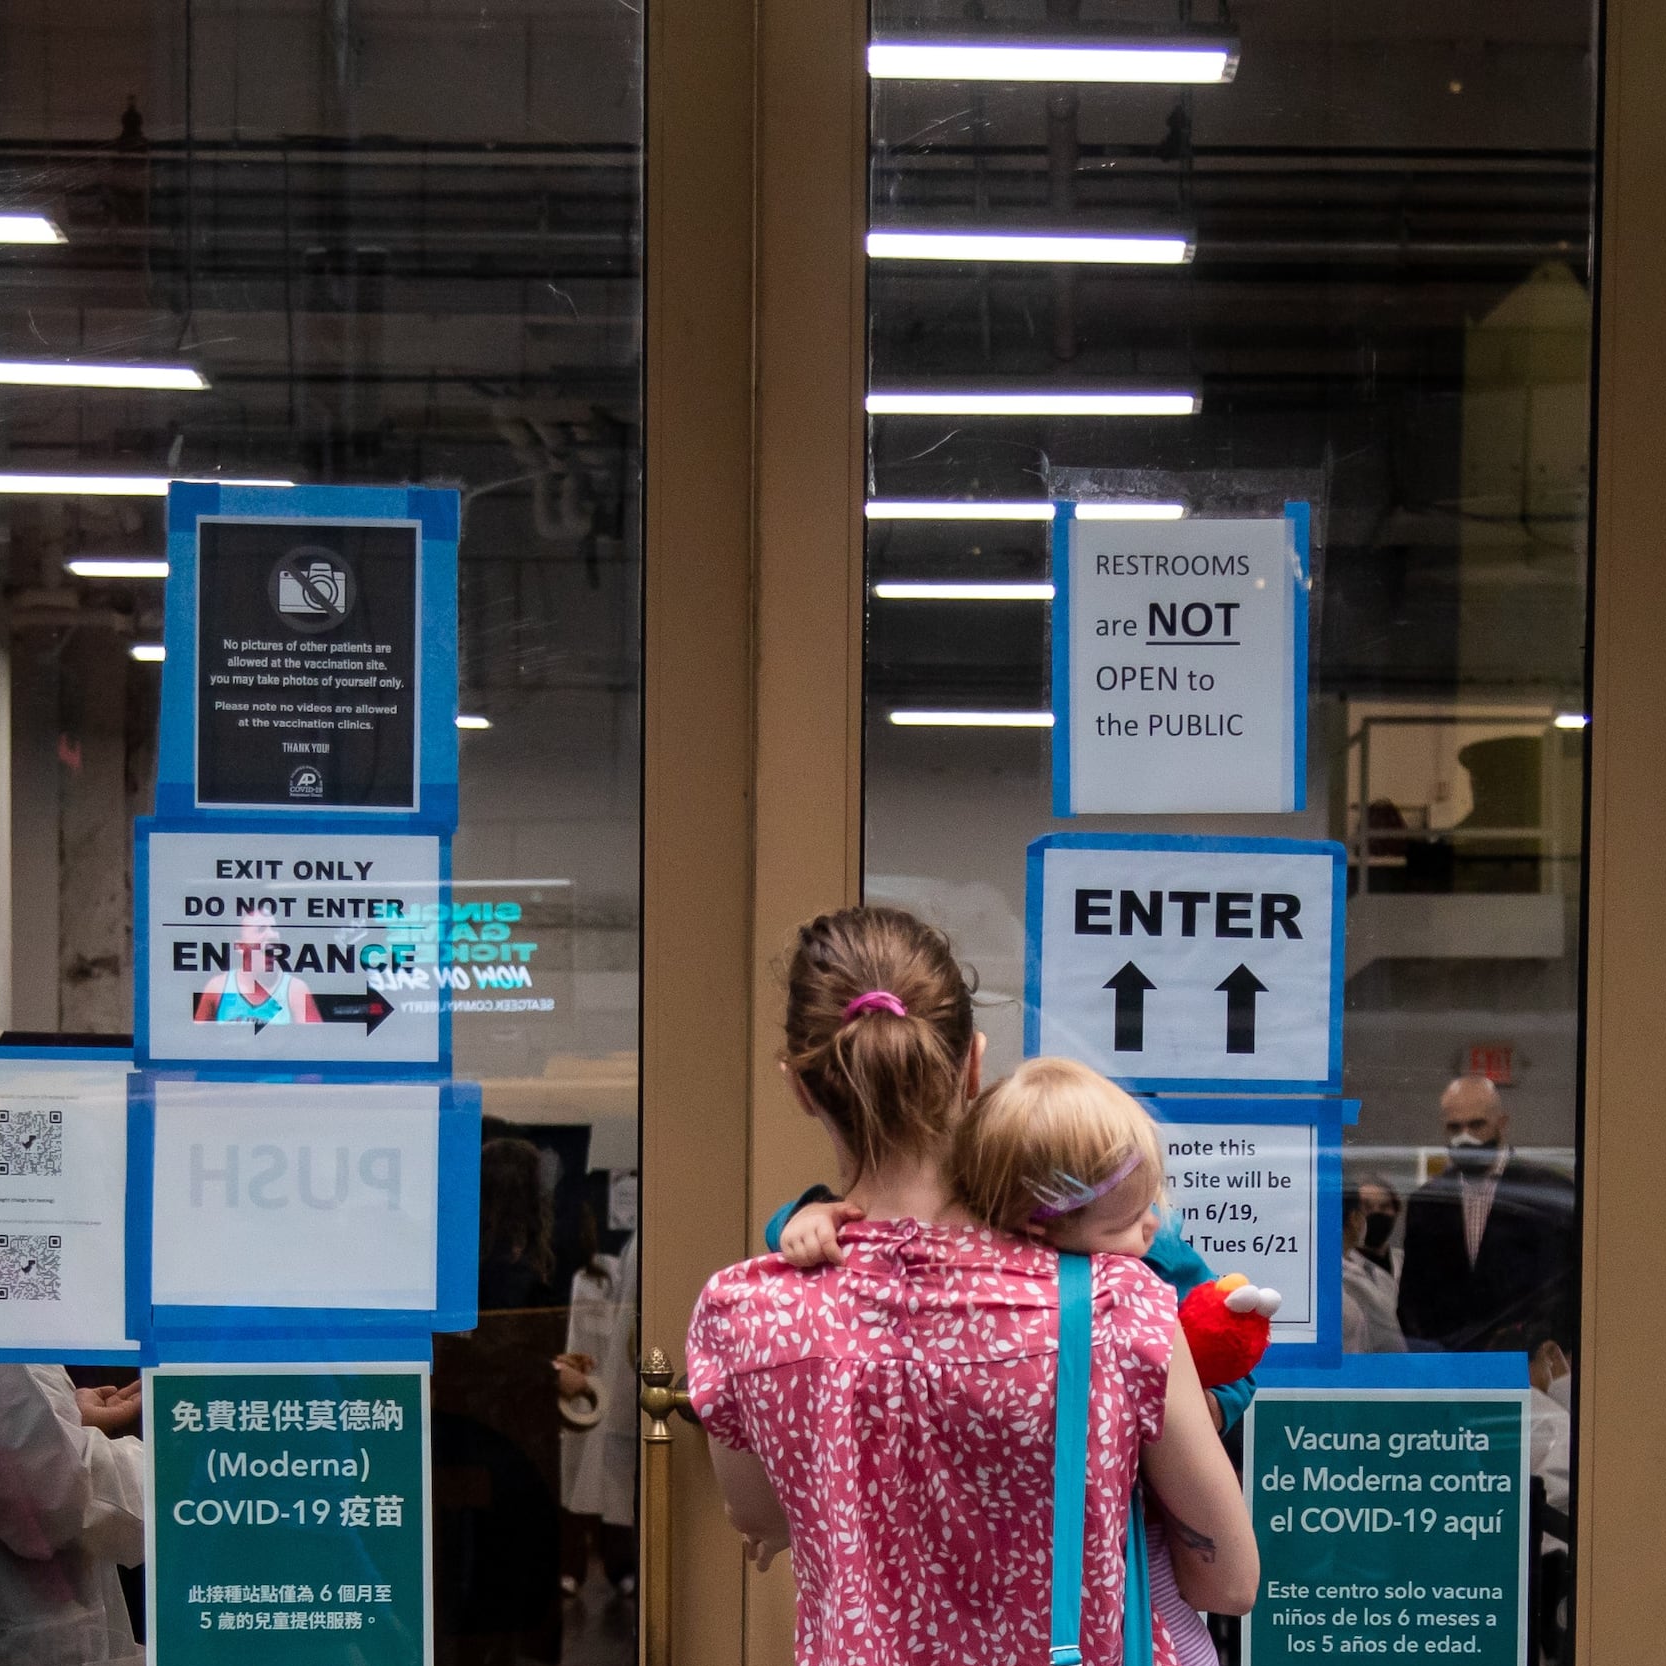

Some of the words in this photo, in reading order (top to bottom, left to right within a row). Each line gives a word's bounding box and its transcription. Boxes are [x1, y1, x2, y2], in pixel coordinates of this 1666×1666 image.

[1096, 554, 1250, 576] RESTROOMS
[1095, 619, 1138, 637] are
[1148, 602, 1241, 638] NOT
[223, 638, 239, 650] No
[241, 640, 283, 654] pictures
[286, 640, 298, 652] of
[300, 641, 328, 653] other
[330, 642, 373, 655] patients
[375, 643, 392, 654] are
[227, 656, 269, 669] allowed
[270, 658, 282, 669] at
[284, 658, 301, 669] the
[304, 658, 364, 670] vaccination
[210, 675, 231, 687] you
[232, 675, 255, 687] may
[257, 674, 280, 686] take
[282, 676, 319, 689] photos
[321, 676, 333, 687] of
[334, 677, 377, 689] yourself
[1096, 665, 1178, 691] OPEN
[1187, 669, 1215, 691] to
[1096, 712, 1139, 736] the
[1149, 713, 1244, 737] PUBLIC
[282, 742, 311, 754] THANK
[311, 742, 331, 755] YOU!
[216, 859, 283, 880] EXIT
[293, 860, 373, 881] ONLY
[184, 896, 225, 917] DO
[236, 897, 297, 918] NOT
[307, 898, 405, 919] ENTER
[1074, 888, 1303, 940] ENTER
[173, 941, 416, 974] ENTRANCE
[1168, 1141, 1213, 1156] note
[1219, 1139, 1256, 1157] this
[1183, 1171, 1220, 1188] Site
[1227, 1171, 1261, 1188] will
[1268, 1171, 1292, 1188] be
[1206, 1203, 1258, 1224] 6/19,
[1201, 1236, 1246, 1253] Tues
[1252, 1234, 1298, 1256] 6/21
[171, 1399, 404, 1432] 免費提供莫德納
[1284, 1426, 1380, 1451] Vacuna
[1388, 1426, 1490, 1458] gratuita
[207, 1448, 370, 1483] (Moderna)
[1261, 1465, 1295, 1492] de
[1303, 1465, 1422, 1492] Moderna
[1429, 1470, 1512, 1492] contra
[173, 1498, 331, 1526] COVID-19
[339, 1494, 405, 1528] 疫苗
[1270, 1506, 1293, 1532] el
[1300, 1507, 1437, 1533] COVID-19
[1443, 1508, 1505, 1541] aquí
[319, 1584, 333, 1602] 6
[337, 1584, 393, 1604] 個月至
[1267, 1581, 1309, 1600] Este
[1315, 1583, 1379, 1600] centro
[1384, 1580, 1426, 1600] solo
[1432, 1585, 1503, 1600] vacuna
[200, 1611, 212, 1630] 5
[1272, 1608, 1326, 1627] niños
[1331, 1608, 1358, 1627] de
[1363, 1608, 1392, 1627] los
[1397, 1609, 1410, 1626] 6
[1416, 1612, 1480, 1627] meses
[1485, 1613, 1497, 1627] a
[1287, 1634, 1316, 1653] los
[1322, 1635, 1333, 1653] 5
[1340, 1635, 1387, 1653] años
[1393, 1634, 1419, 1653] de
[1424, 1634, 1482, 1653] edad.
